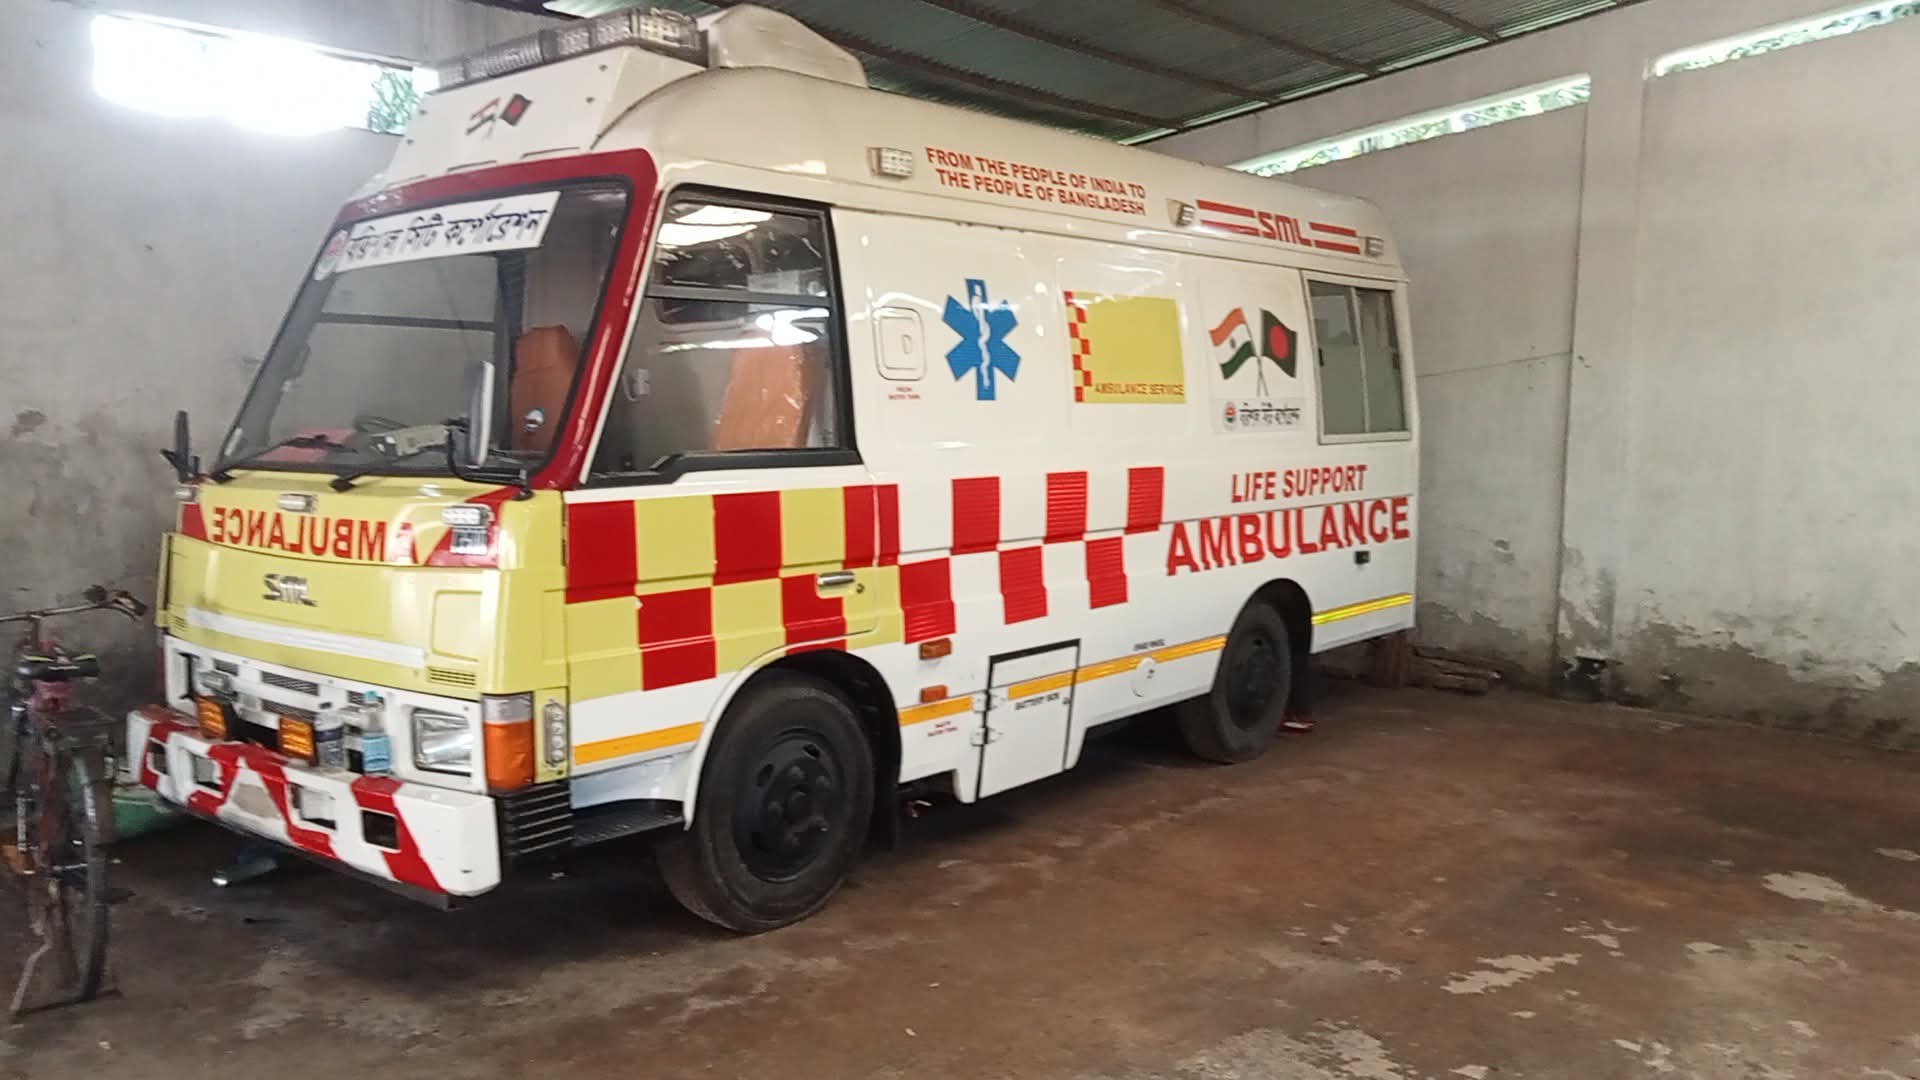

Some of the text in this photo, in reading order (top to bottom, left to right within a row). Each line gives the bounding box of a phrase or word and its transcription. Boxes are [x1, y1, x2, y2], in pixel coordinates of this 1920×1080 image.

[926, 147, 1146, 200] FROM THE PEOPLE OF INDIA TO
[937, 168, 1146, 217] THE PEOPLE OF BANGLADESH
[1257, 210, 1313, 247] SML
[1231, 464, 1368, 503] LIFE SUPPORT
[1166, 496, 1410, 577] AMBULANCE
